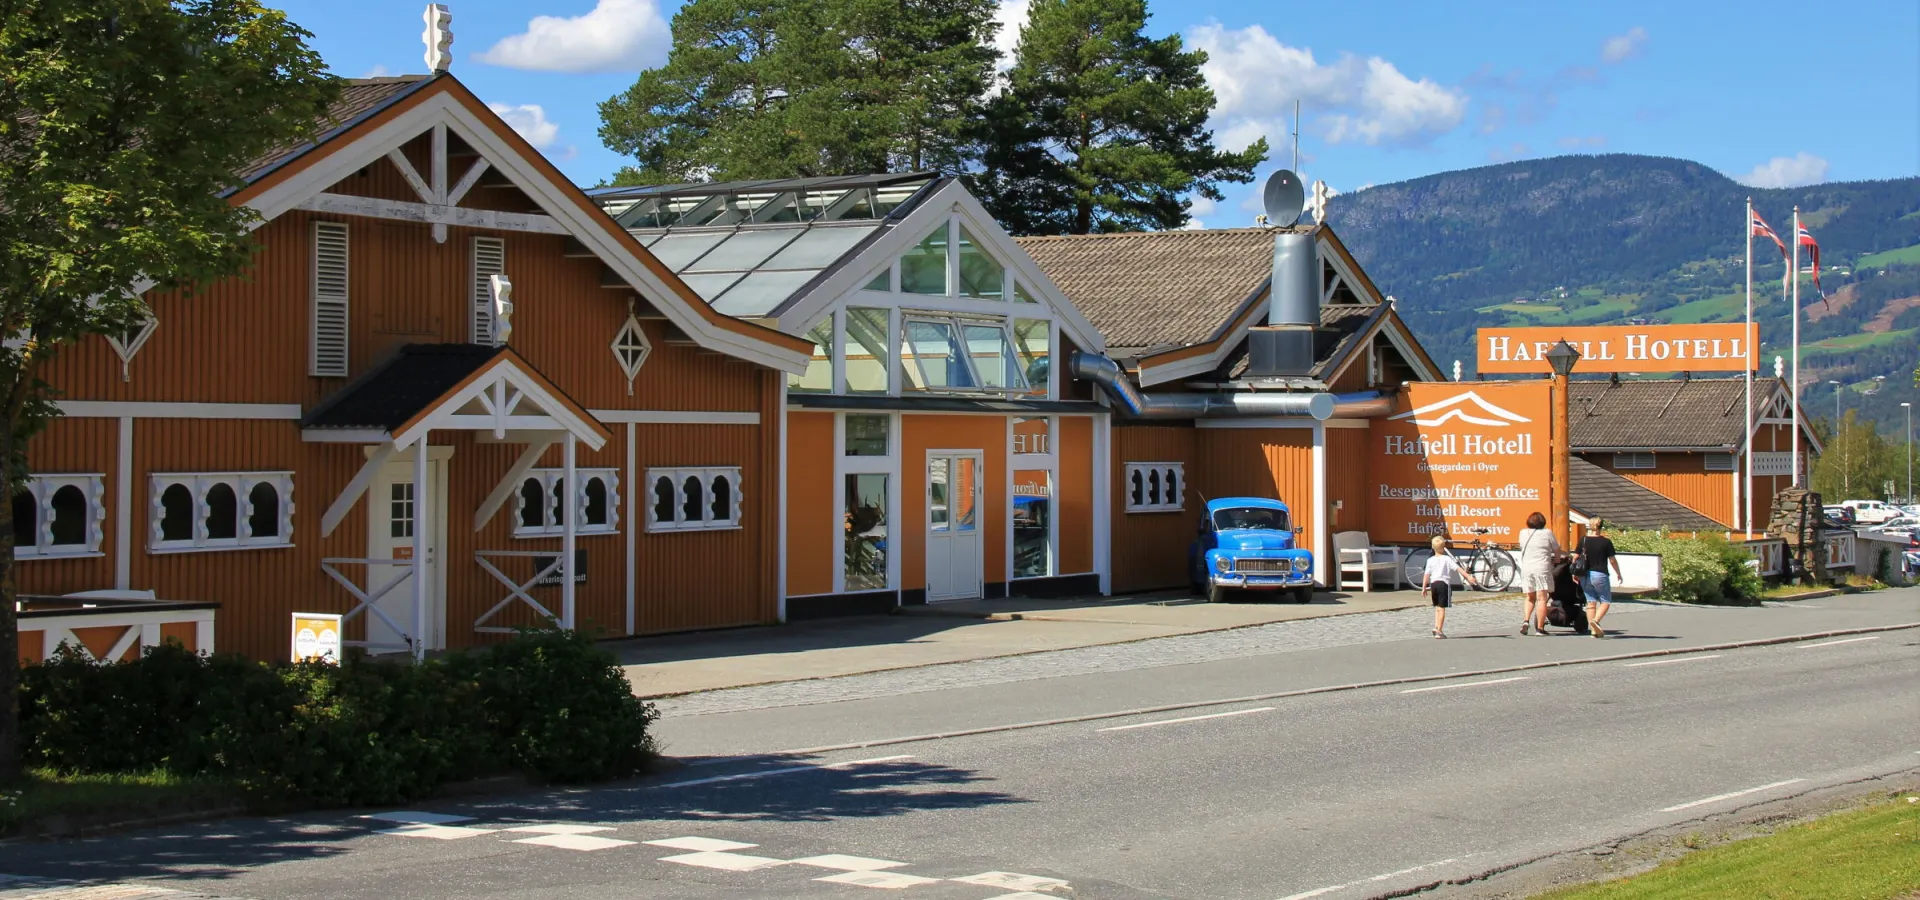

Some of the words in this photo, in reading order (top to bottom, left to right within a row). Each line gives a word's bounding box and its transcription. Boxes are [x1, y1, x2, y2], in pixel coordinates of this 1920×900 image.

[1624, 334, 1747, 360] HOTELL
[1384, 434, 1456, 460] Hafjell
[1463, 433, 1532, 455] Hotell
[1417, 463, 1471, 473] Gjestegarden
[1473, 463, 1477, 471] i
[1478, 462, 1498, 473] Øyer
[1379, 484, 1491, 500] Resepsjon/front
[1495, 484, 1539, 499] office:
[1415, 504, 1456, 519] Hafjell
[1460, 505, 1501, 517] Resort
